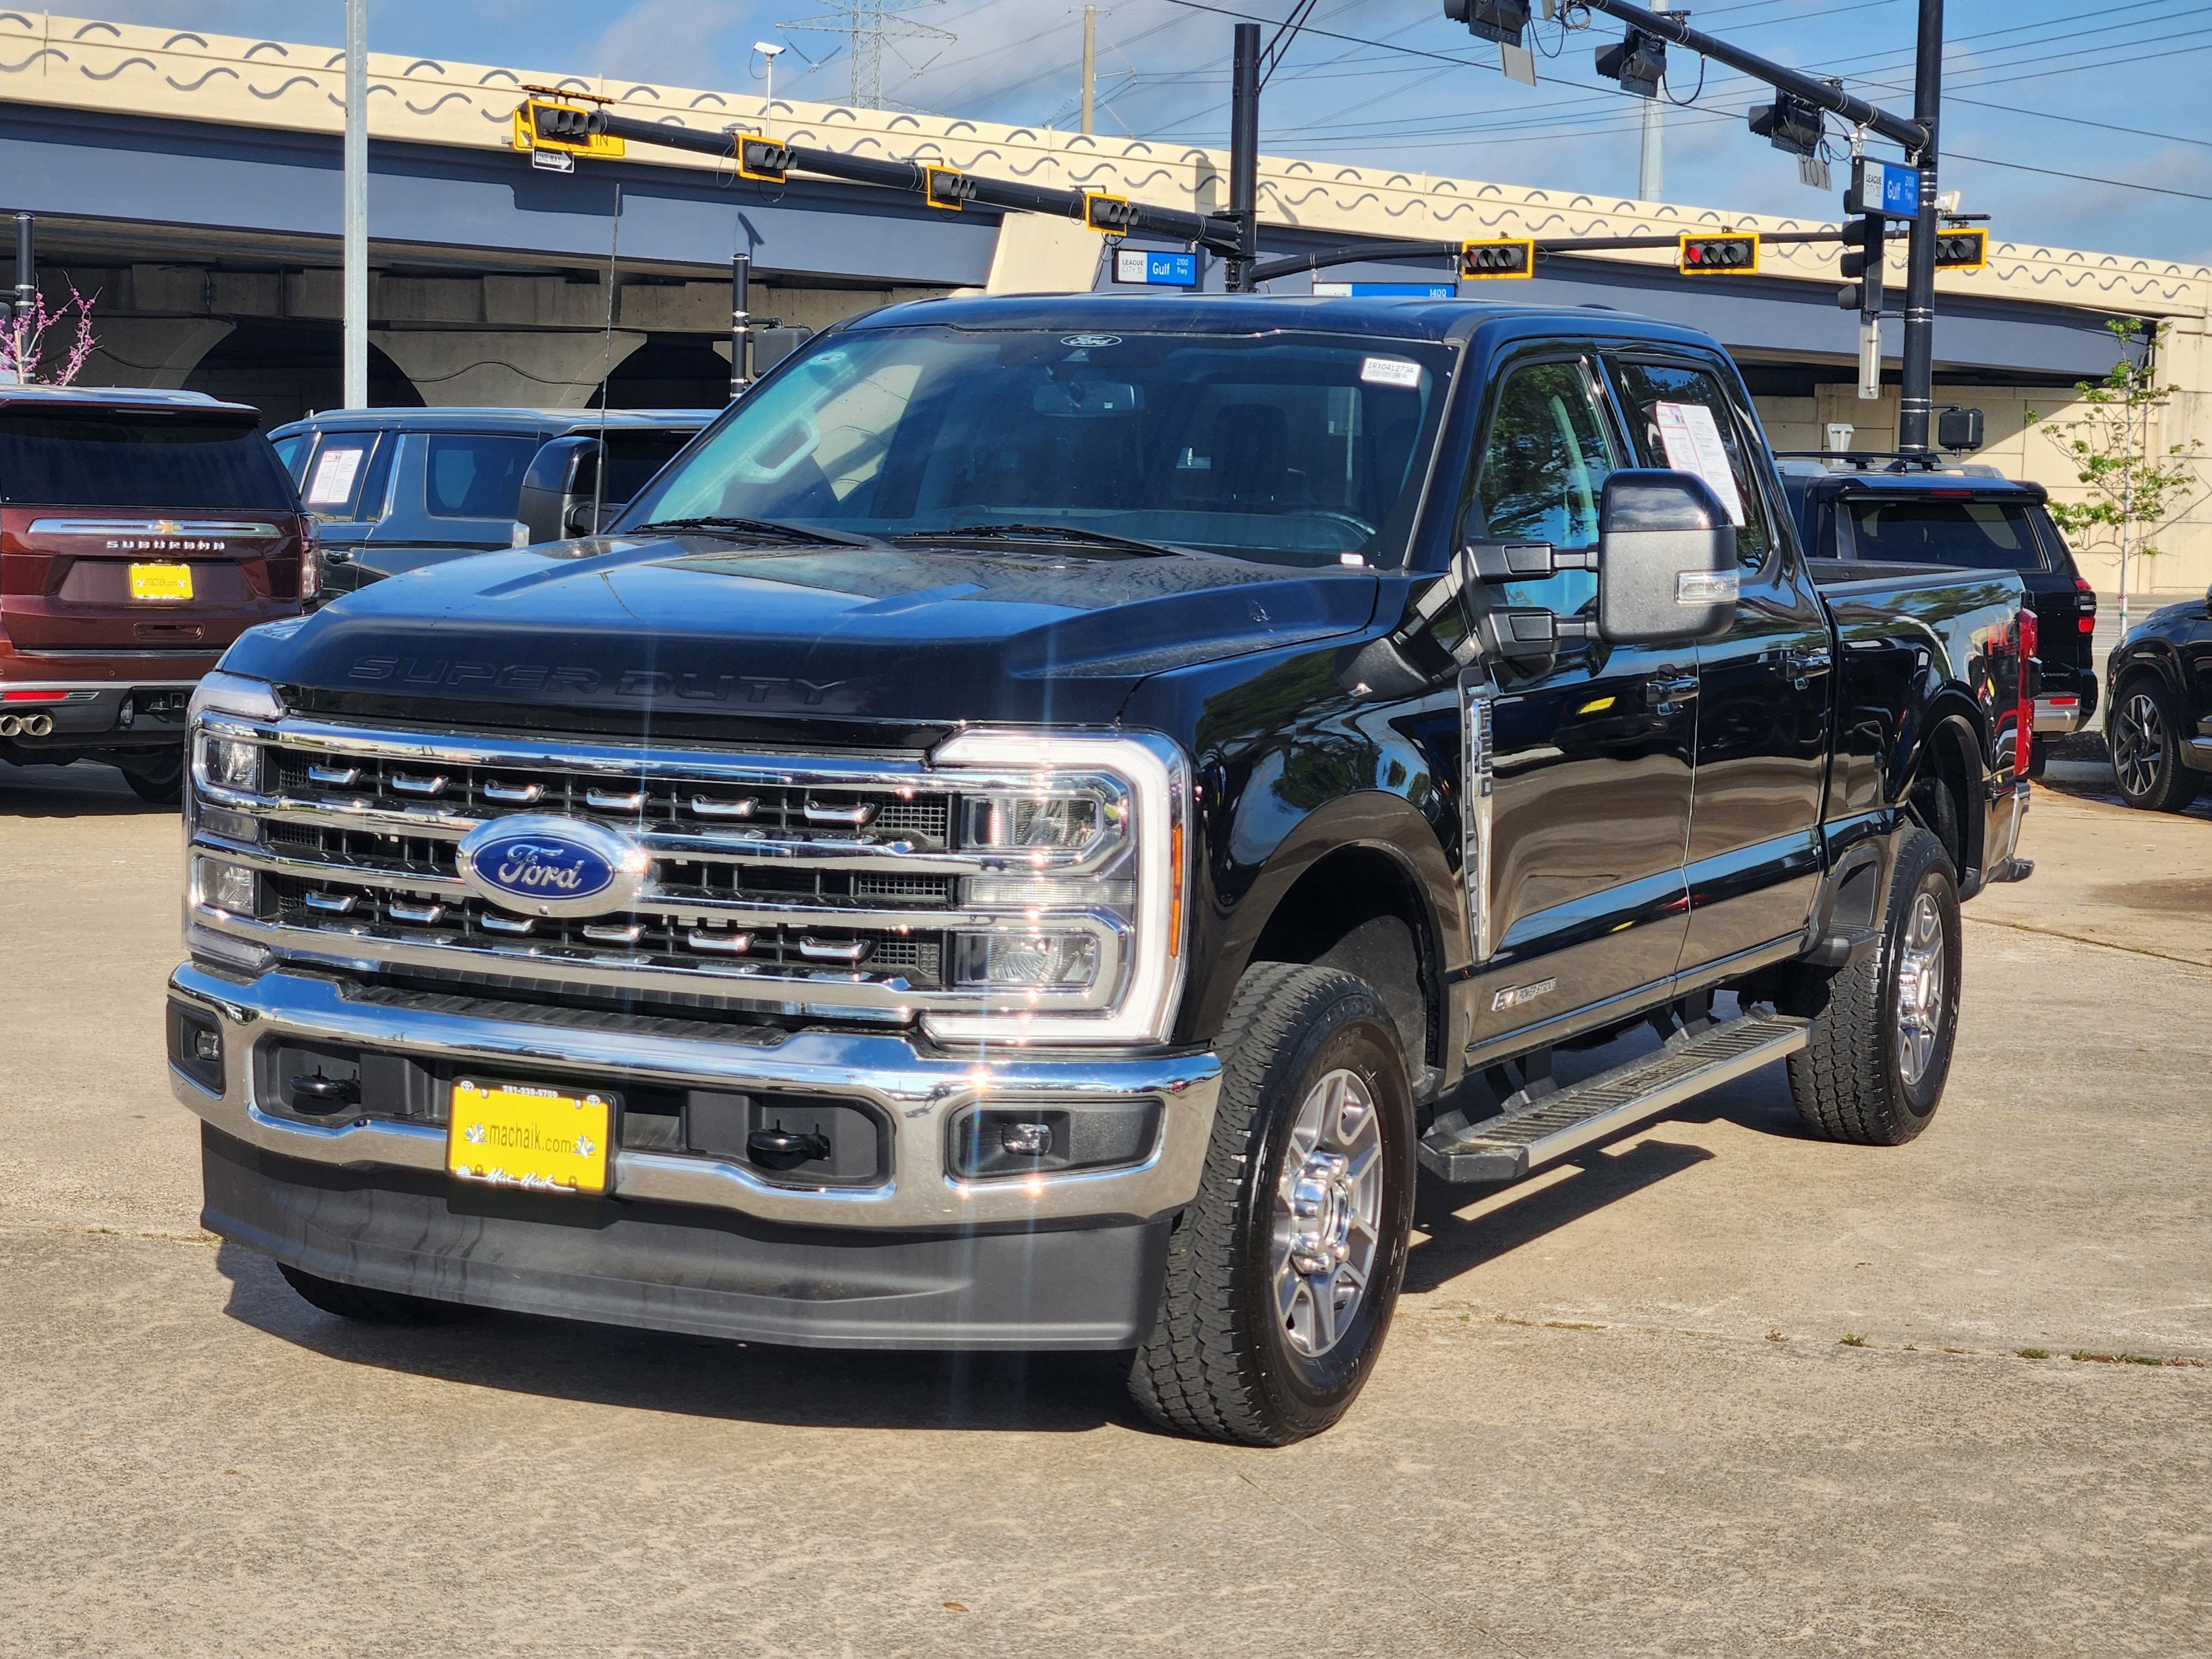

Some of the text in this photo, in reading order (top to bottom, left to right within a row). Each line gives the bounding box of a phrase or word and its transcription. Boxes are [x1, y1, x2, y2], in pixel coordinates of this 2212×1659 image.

[538, 152, 562, 164] ONE WAY
[1866, 173, 1882, 185] LEAGUE
[1887, 180, 1901, 200] Gulf
[1176, 258, 1189, 266] 2100
[1152, 262, 1170, 275] Gulf
[1177, 267, 1188, 275] Fwy
[1069, 335, 1113, 345] Ford
[106, 540, 226, 550] SUBURBAN
[348, 656, 847, 705] SUPER DUTY
[498, 844, 583, 889] Ford
[489, 1120, 572, 1154] machaik.com
[486, 1167, 557, 1189] Mac Haik
